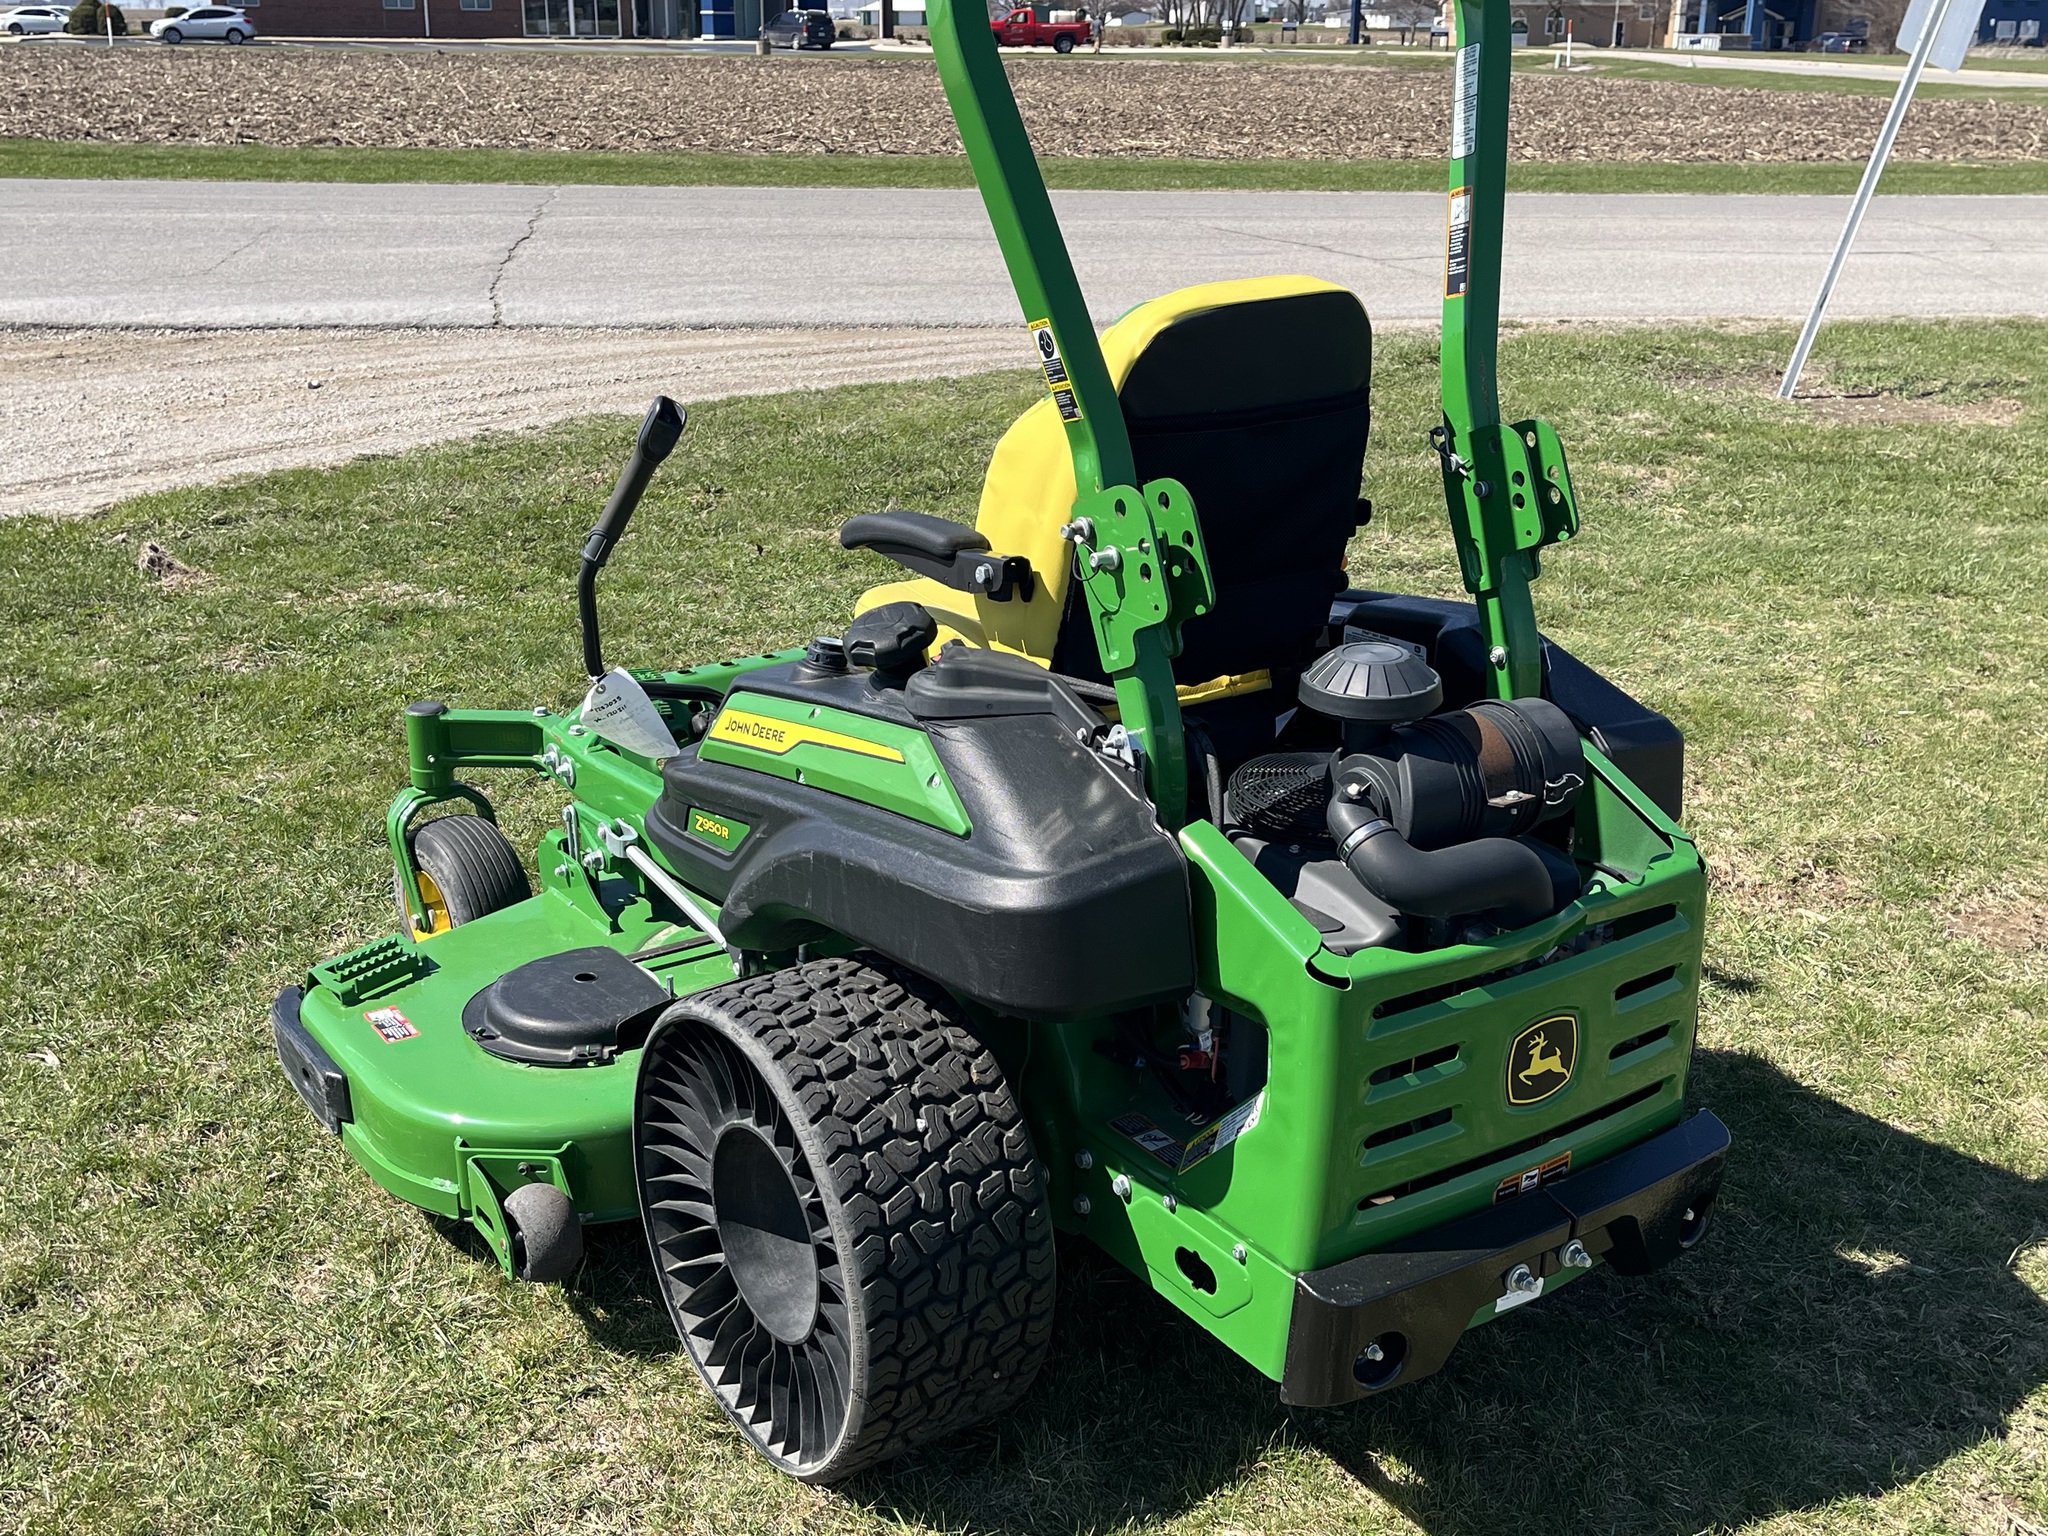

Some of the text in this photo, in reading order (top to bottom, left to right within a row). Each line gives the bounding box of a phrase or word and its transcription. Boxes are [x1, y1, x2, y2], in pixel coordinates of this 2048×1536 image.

[725, 716, 786, 743] JOHN DEERE
[695, 815, 729, 839] Z950R
[851, 1297, 860, 1317] NOT
[855, 1322, 863, 1341] FOR
